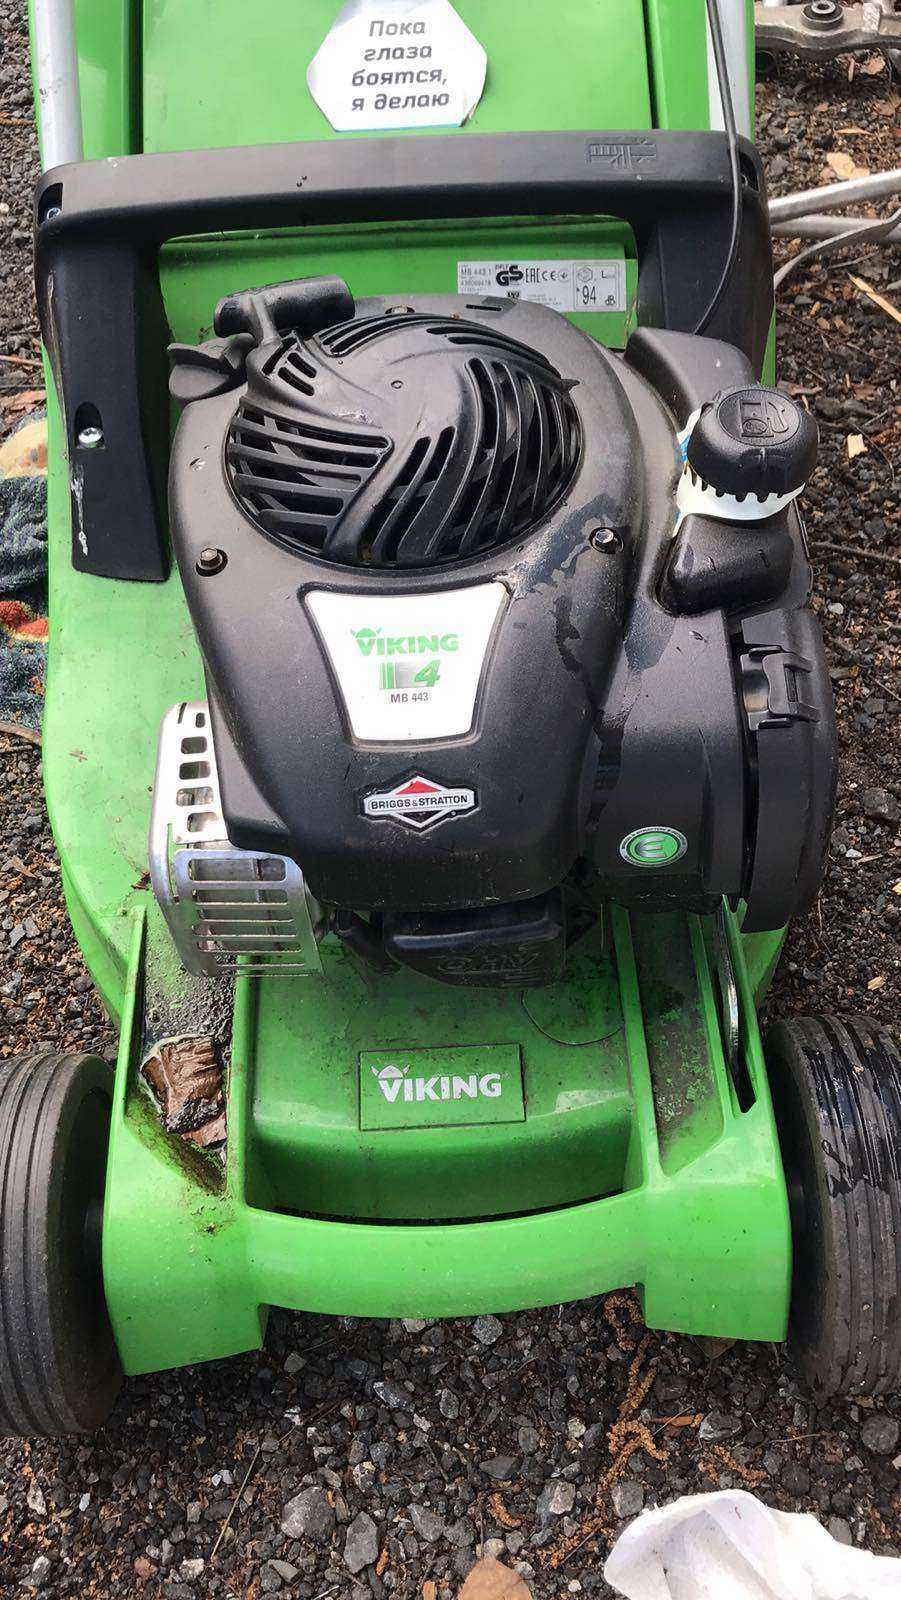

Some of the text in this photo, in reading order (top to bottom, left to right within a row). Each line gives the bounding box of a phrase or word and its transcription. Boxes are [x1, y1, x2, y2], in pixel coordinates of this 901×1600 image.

[369, 20, 426, 37] Пока
[364, 45, 432, 62] глаза
[352, 69, 448, 87] боятся,
[351, 93, 450, 111] я делаю
[582, 285, 597, 305] 94
[356, 634, 459, 656] VIKING
[413, 659, 441, 688] 4
[390, 692, 429, 704] MB 443
[378, 1073, 502, 1103] VIKING
